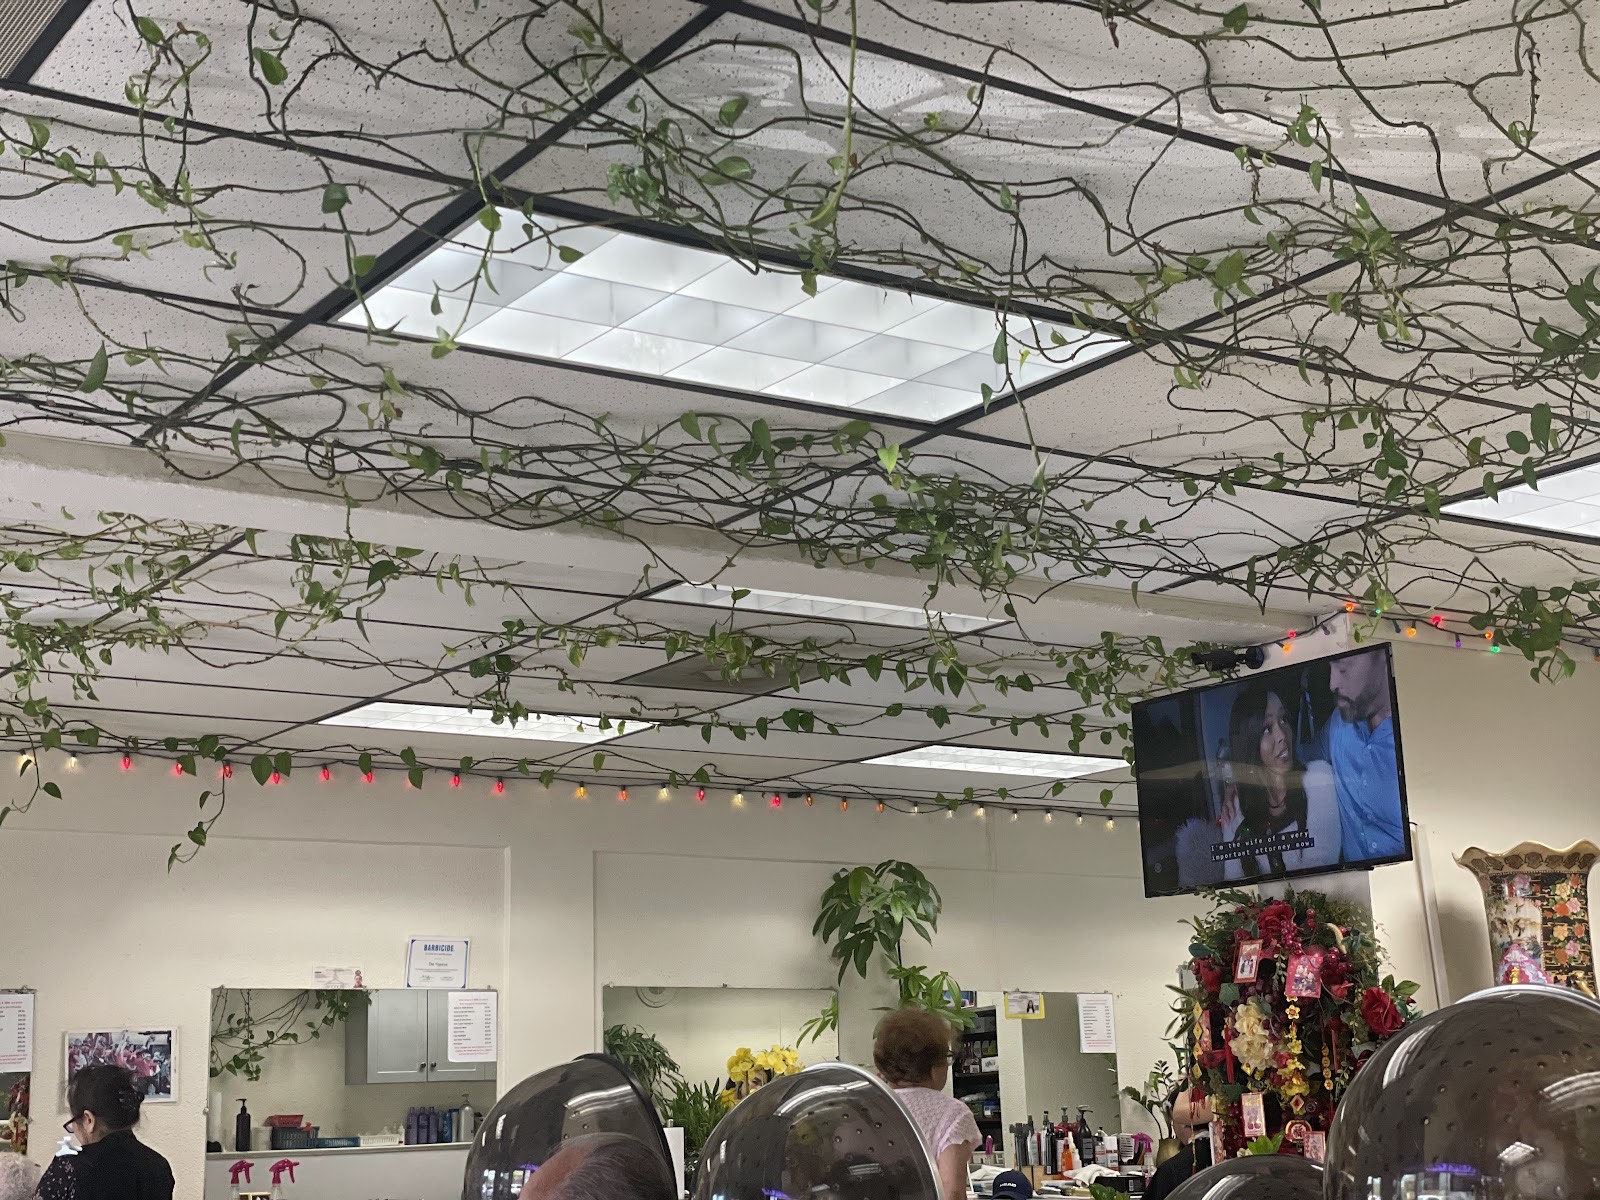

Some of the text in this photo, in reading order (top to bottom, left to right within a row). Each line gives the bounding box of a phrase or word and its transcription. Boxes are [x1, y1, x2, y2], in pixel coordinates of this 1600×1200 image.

[1245, 838, 1263, 846] wife
[1268, 835, 1276, 843] of
[1290, 831, 1309, 839] very
[1211, 849, 1250, 861] important
[1255, 844, 1291, 854] attorney
[423, 944, 454, 952] BARBICIDE
